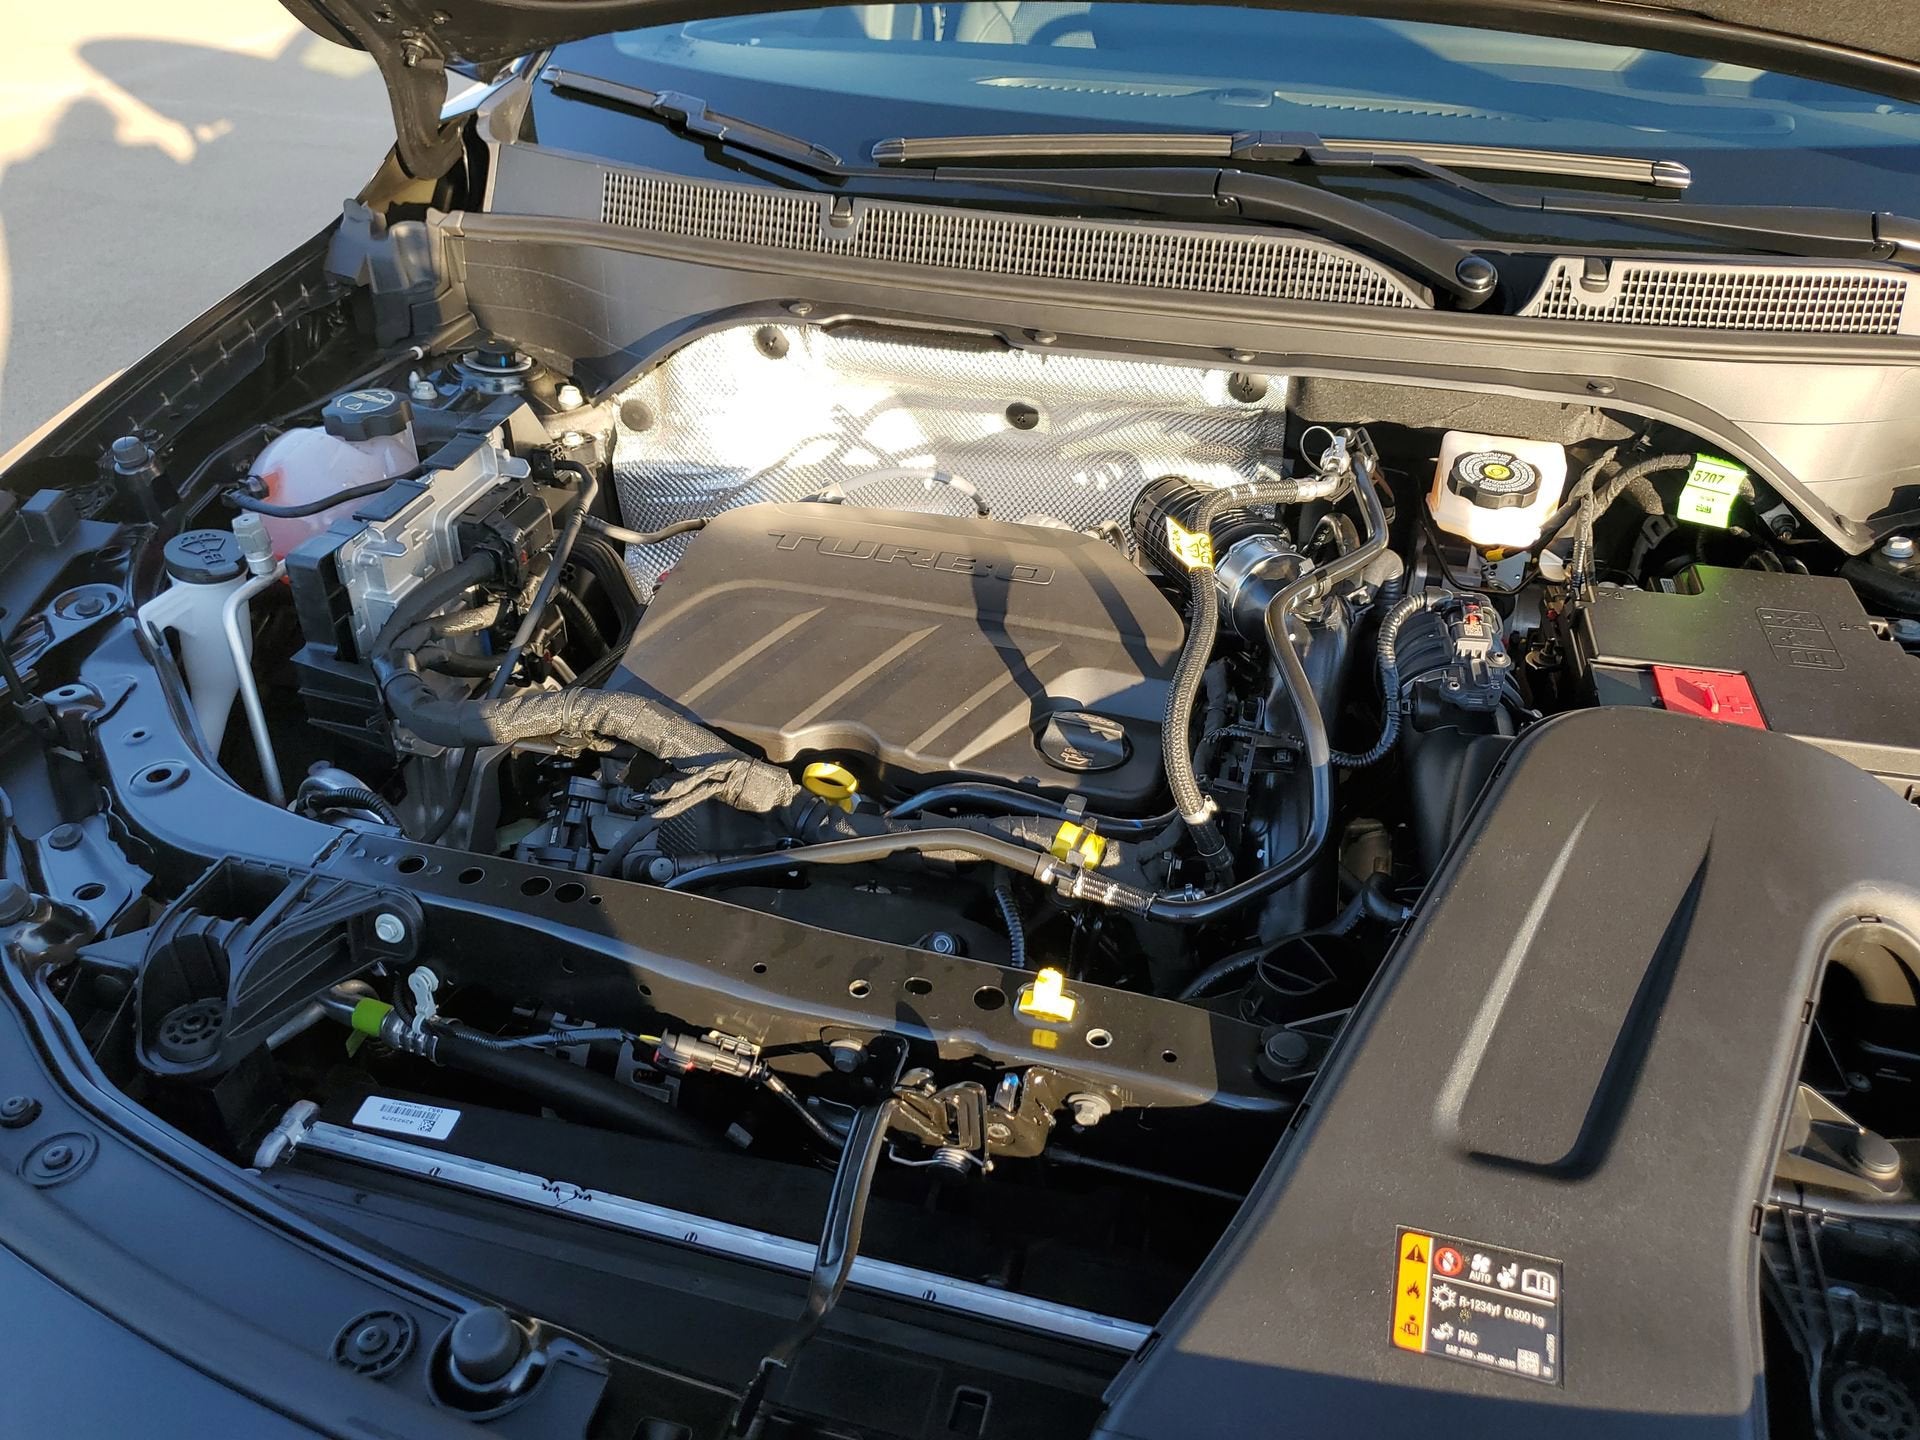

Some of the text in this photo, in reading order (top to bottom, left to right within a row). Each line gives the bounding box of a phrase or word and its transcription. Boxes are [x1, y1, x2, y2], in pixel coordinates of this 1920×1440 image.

[768, 530, 1056, 585] TURBO
[1469, 1271, 1491, 1284] AUTO
[1532, 1311, 1545, 1329] kg
[1457, 1329, 1479, 1346] PAG
